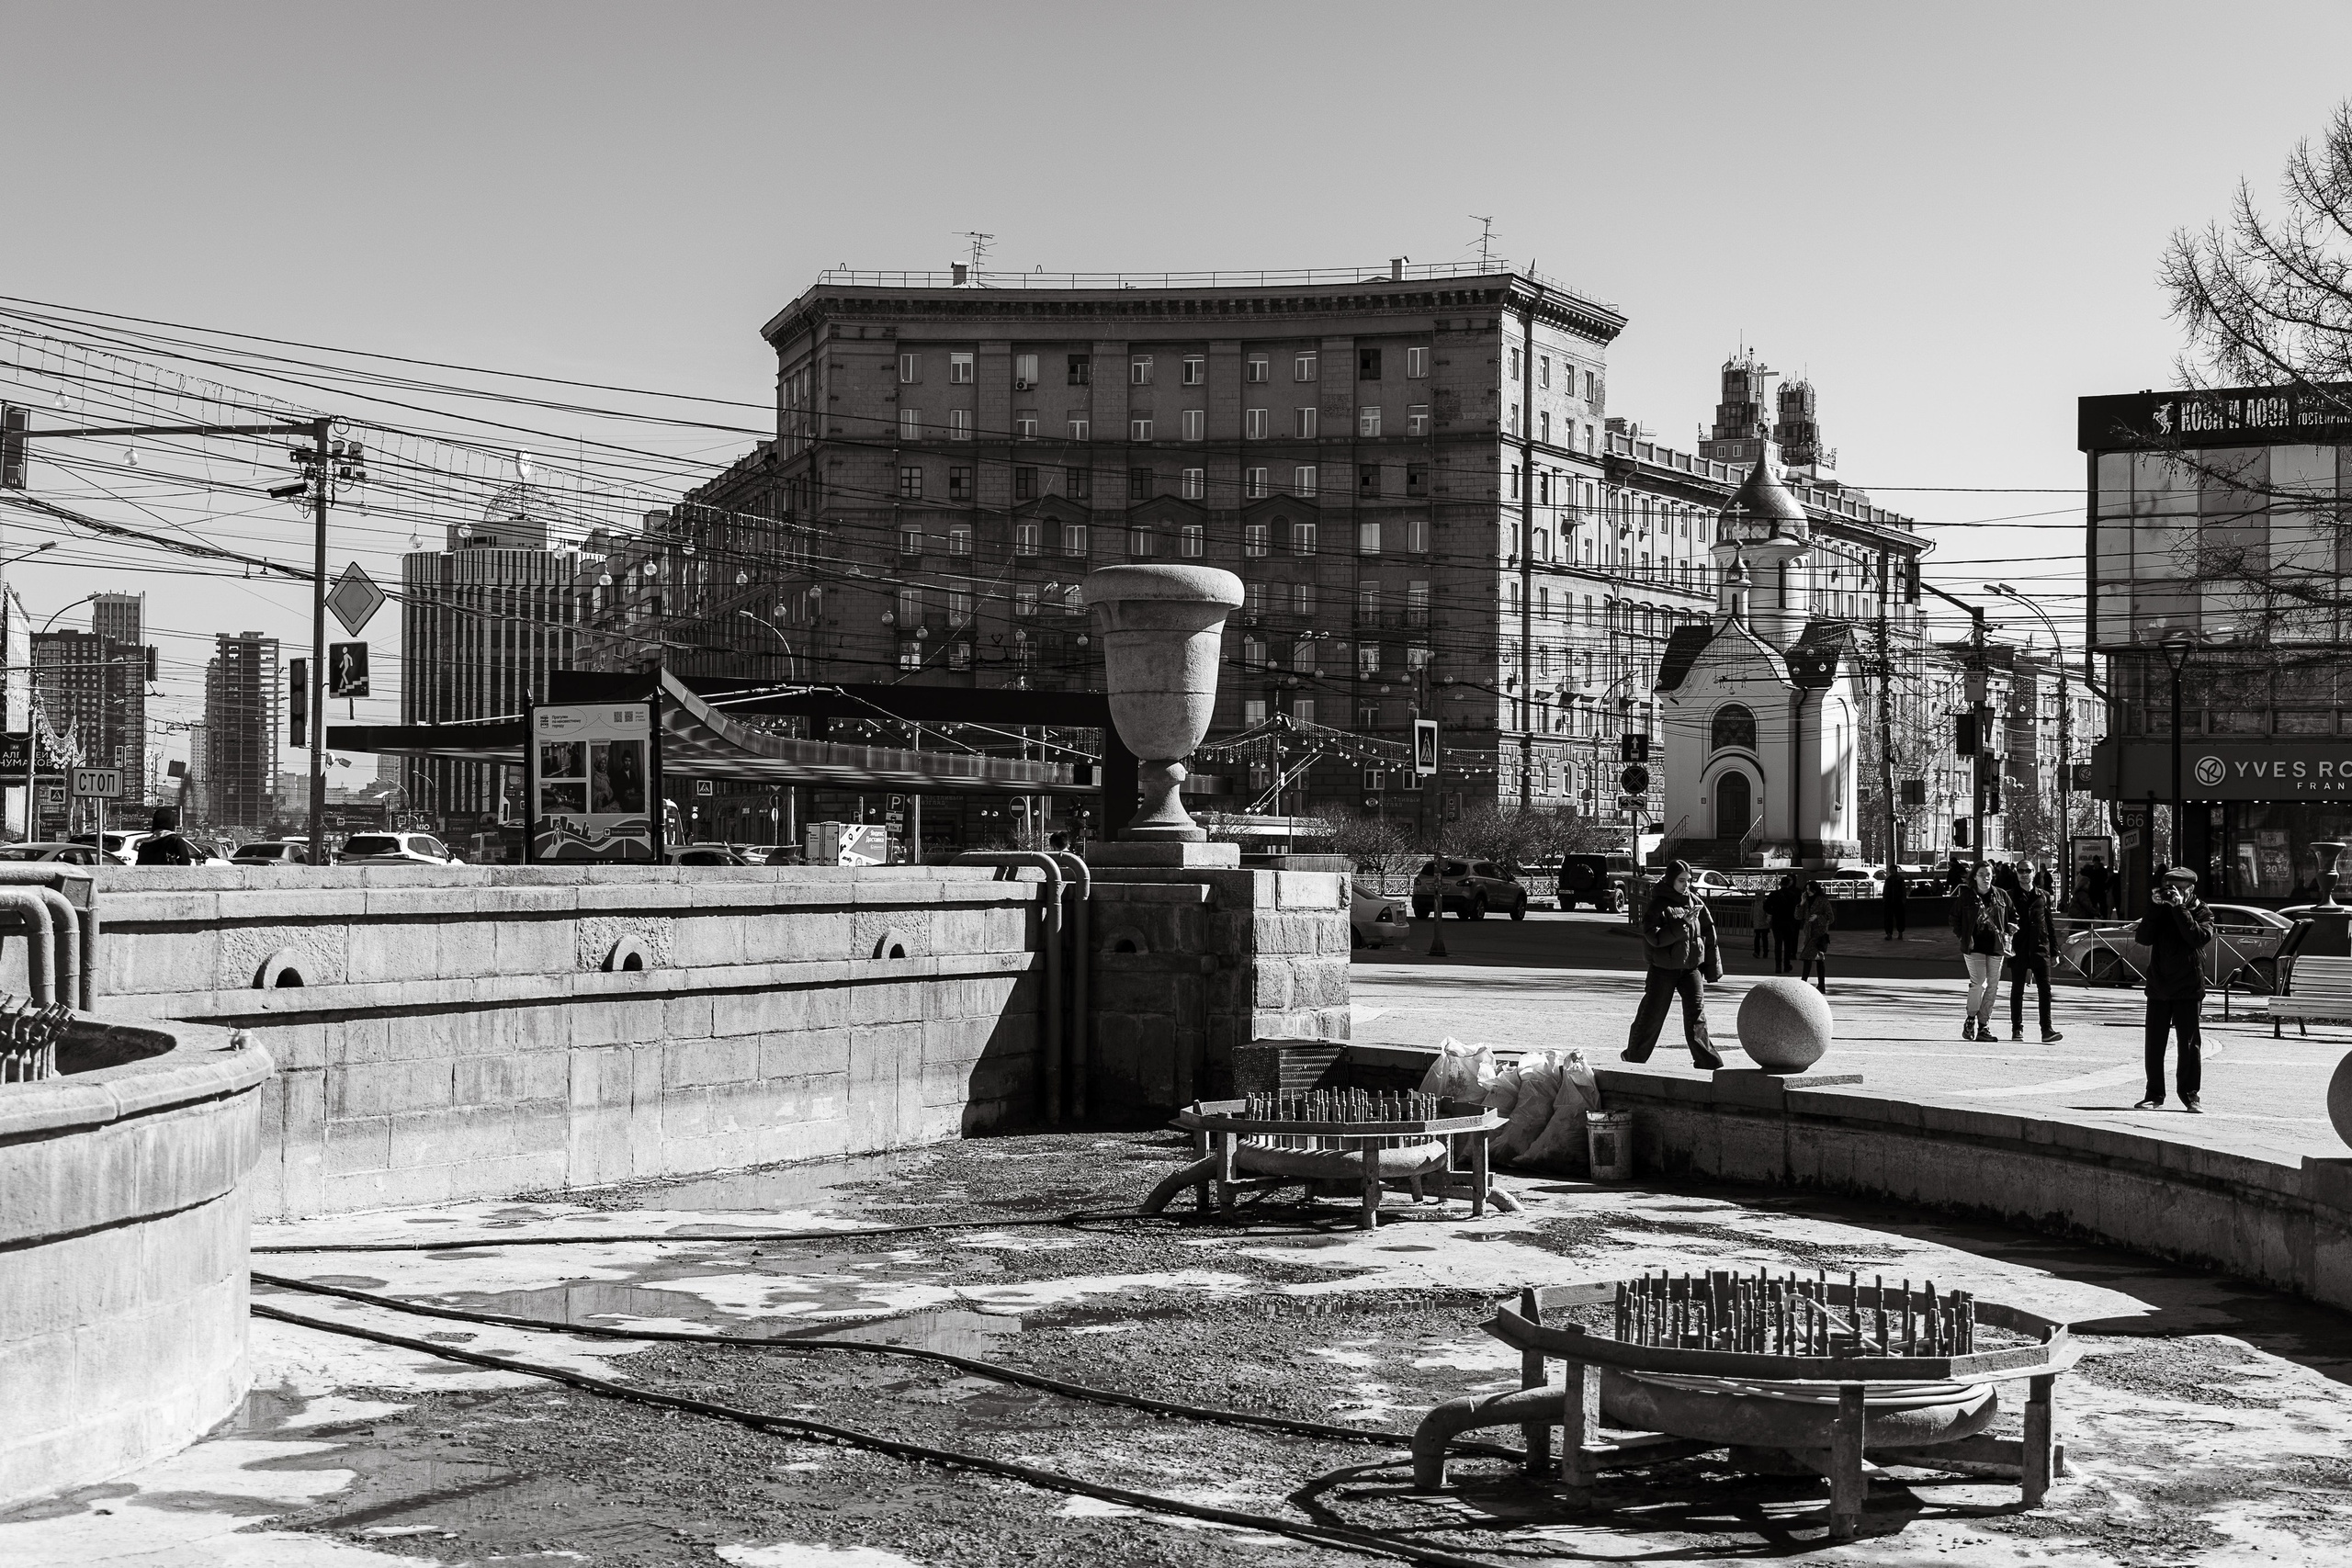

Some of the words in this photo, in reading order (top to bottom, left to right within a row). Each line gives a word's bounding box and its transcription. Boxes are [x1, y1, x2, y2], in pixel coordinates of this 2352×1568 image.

[2181, 401, 2224, 432] КОЗА
[2228, 400, 2240, 429] И
[2245, 398, 2290, 428] ЛОЗА
[2234, 761, 2306, 778] YVES
[2319, 761, 2352, 778] RO
[79, 773, 116, 793] СТОП
[2297, 782, 2345, 790] FRAN
[891, 796, 901, 809] P
[2126, 813, 2144, 828] 66
